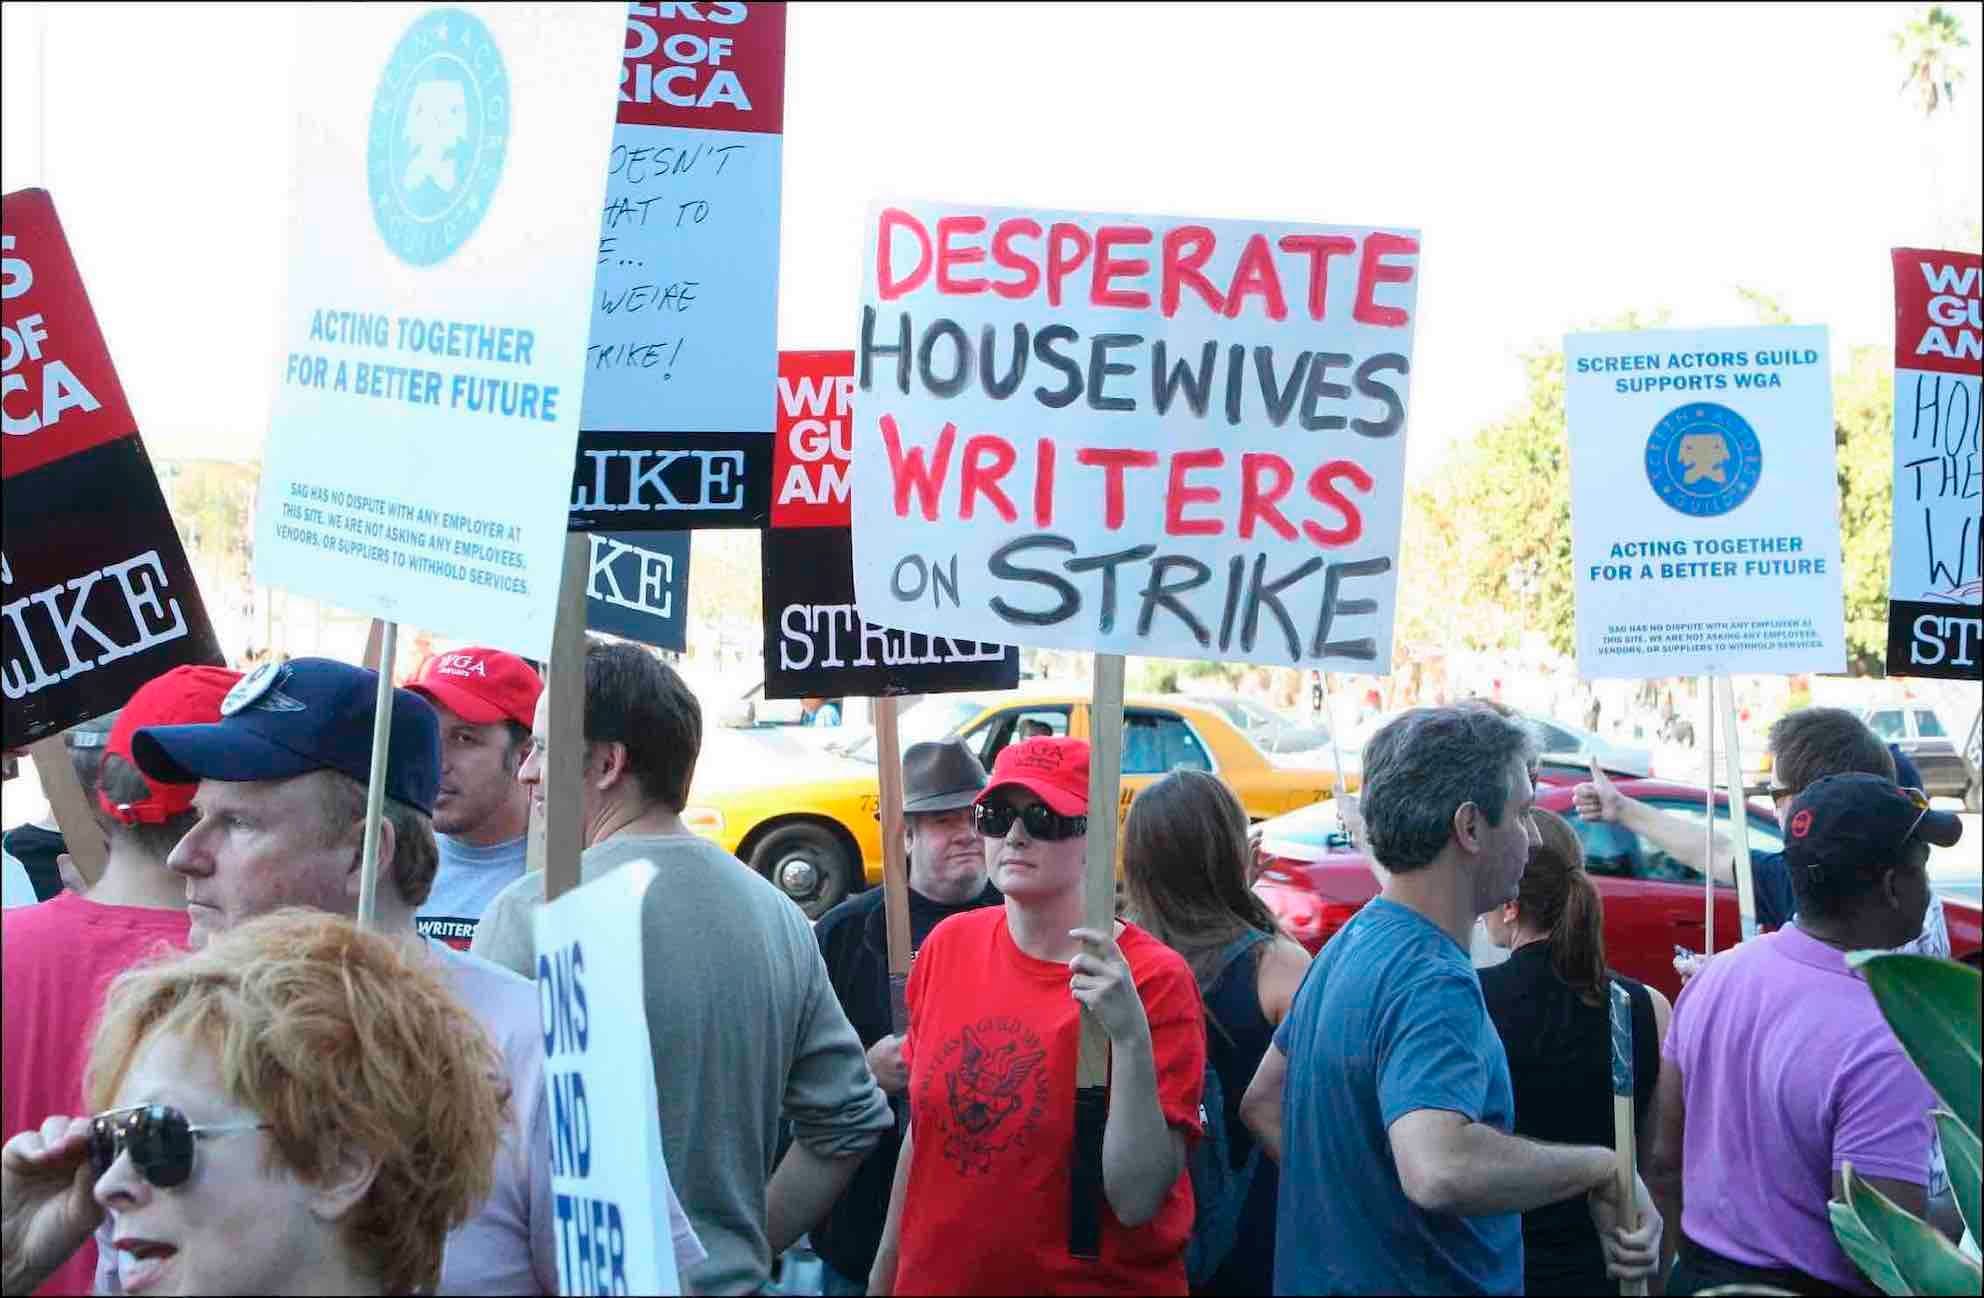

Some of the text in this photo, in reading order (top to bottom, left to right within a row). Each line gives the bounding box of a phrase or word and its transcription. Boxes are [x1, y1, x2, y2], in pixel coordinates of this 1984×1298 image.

[664, 34, 733, 65] OF
[676, 200, 710, 229] TO
[875, 208, 1419, 327] DESPERATE
[1920, 262, 1982, 298] W
[309, 308, 536, 366] ACTING TOGETHER
[1577, 349, 1819, 373] SCREEN ACTORS GUILD
[286, 353, 560, 423] FOR A BETTER FUTURE
[859, 305, 1410, 438] HOUSEWIVES
[1615, 372, 1782, 393] SUPPORTS WGA
[880, 413, 1374, 548] WRITERS
[283, 502, 303, 520] THIS
[327, 512, 343, 529] WE
[344, 516, 364, 534] ARE
[365, 521, 384, 538] NOT
[386, 524, 426, 548] ASKING
[429, 536, 452, 553] ANY
[291, 482, 522, 543] SAG HAS NO DISPUTE WITH ANY EMPLOYER AT
[323, 533, 337, 552] OR
[338, 539, 389, 564] SUPPLIERS
[392, 551, 406, 568] TO
[409, 555, 467, 581] WITHHOLD
[1590, 558, 1826, 581] FOR A BETTER FUTURE
[1610, 536, 1803, 558] ACTING TOGETHER
[586, 533, 673, 619] KE
[890, 534, 1392, 662] ON STRIKE
[1911, 614, 1982, 665] ST
[549, 1071, 591, 1180] ND
